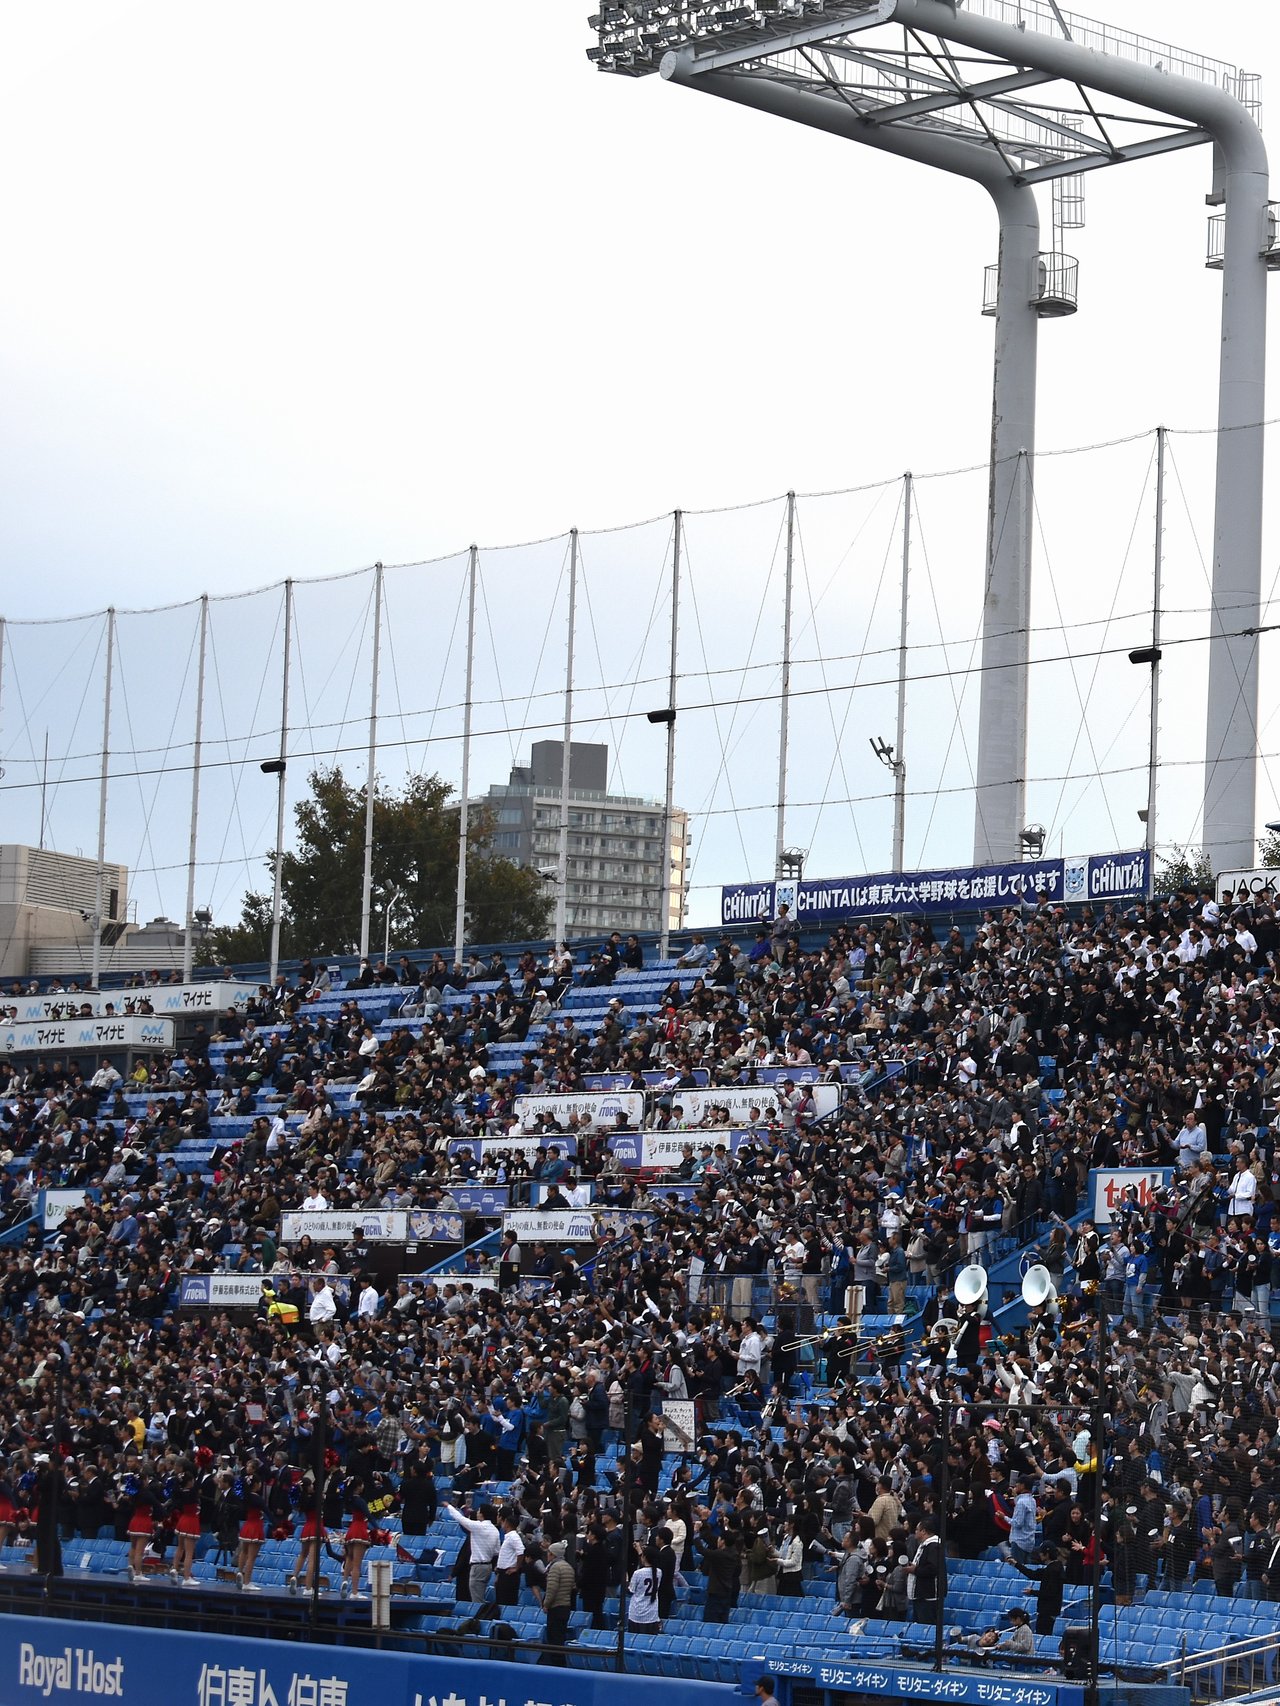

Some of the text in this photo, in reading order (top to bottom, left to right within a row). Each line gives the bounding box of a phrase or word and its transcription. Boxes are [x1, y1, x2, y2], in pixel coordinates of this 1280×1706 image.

[1091, 857, 1146, 895] CHINTAI
[798, 869, 1061, 912] CHINTAIは東京六大学野球を応援しています
[723, 887, 771, 922] CHINTAI
[183, 990, 213, 1008] マイナビ
[37, 1028, 66, 1045] マイナビ
[96, 1024, 125, 1041] マイナビ
[141, 1034, 165, 1044] マイナビ
[19, 1642, 124, 1697] Royal Host
[768, 1660, 813, 1675] モリタニ・ダイキン
[820, 1667, 889, 1689] モリタニ・ダイキン
[897, 1676, 969, 1698] モリタニ・ダイキン
[977, 1683, 1052, 1706] モリタニ・ダイキン
